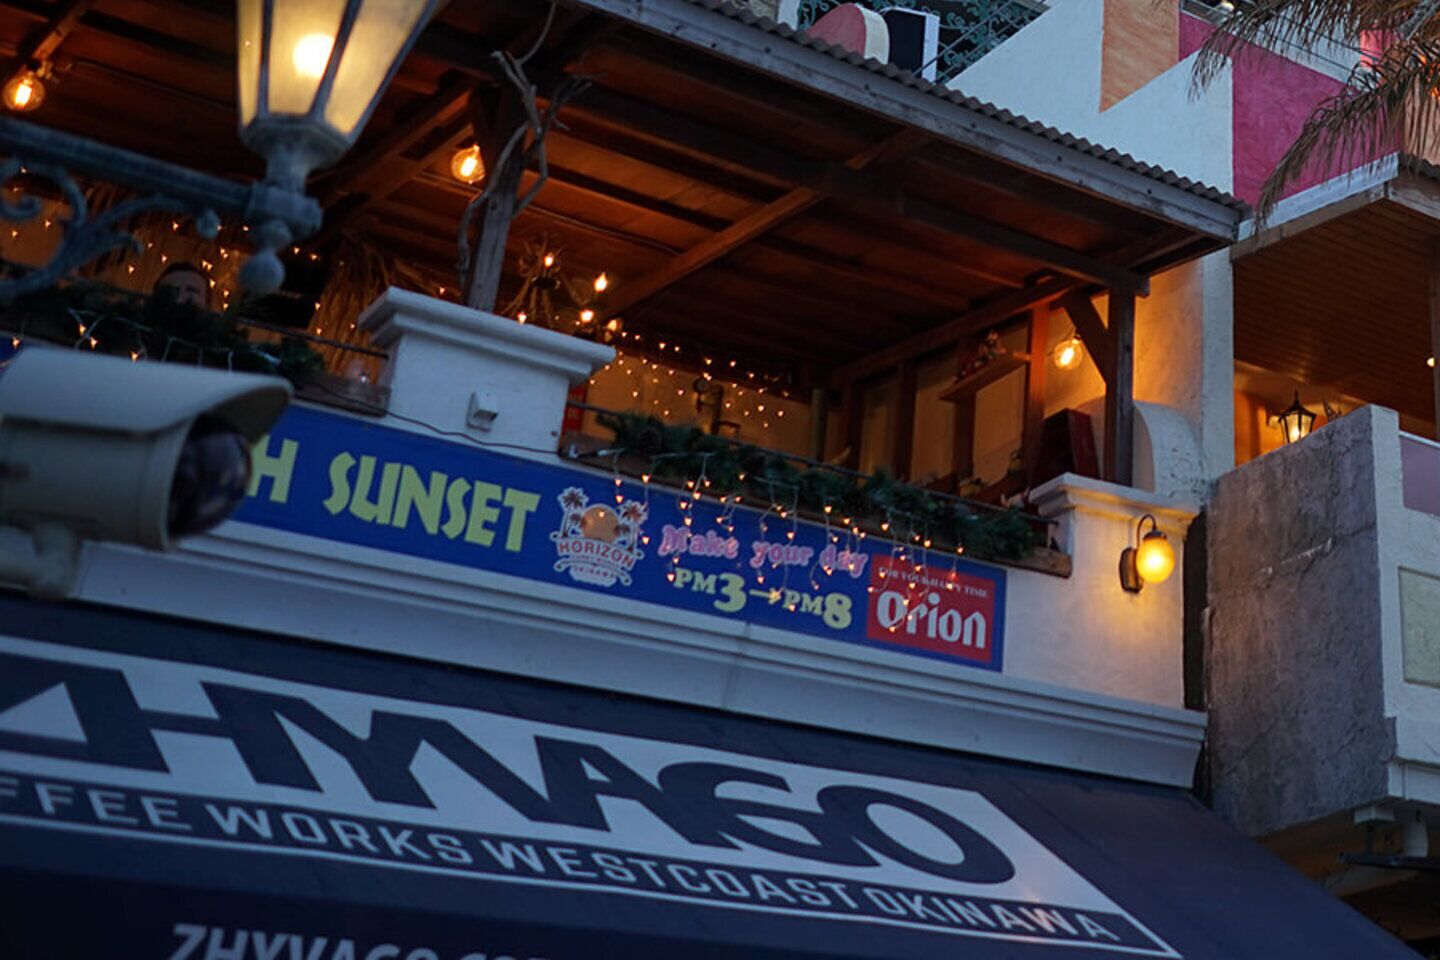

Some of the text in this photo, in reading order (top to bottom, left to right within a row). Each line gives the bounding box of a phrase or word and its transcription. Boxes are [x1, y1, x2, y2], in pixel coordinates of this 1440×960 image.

[323, 451, 541, 552] SUNSET
[559, 540, 635, 568] HORIZON
[658, 524, 868, 578] Make your day
[673, 567, 852, 630] PM3 PM8
[877, 591, 987, 649] Orion
[205, 803, 475, 866] WORKS
[486, 841, 860, 911] WESTCOAST
[875, 885, 1121, 942] OKINAWA
